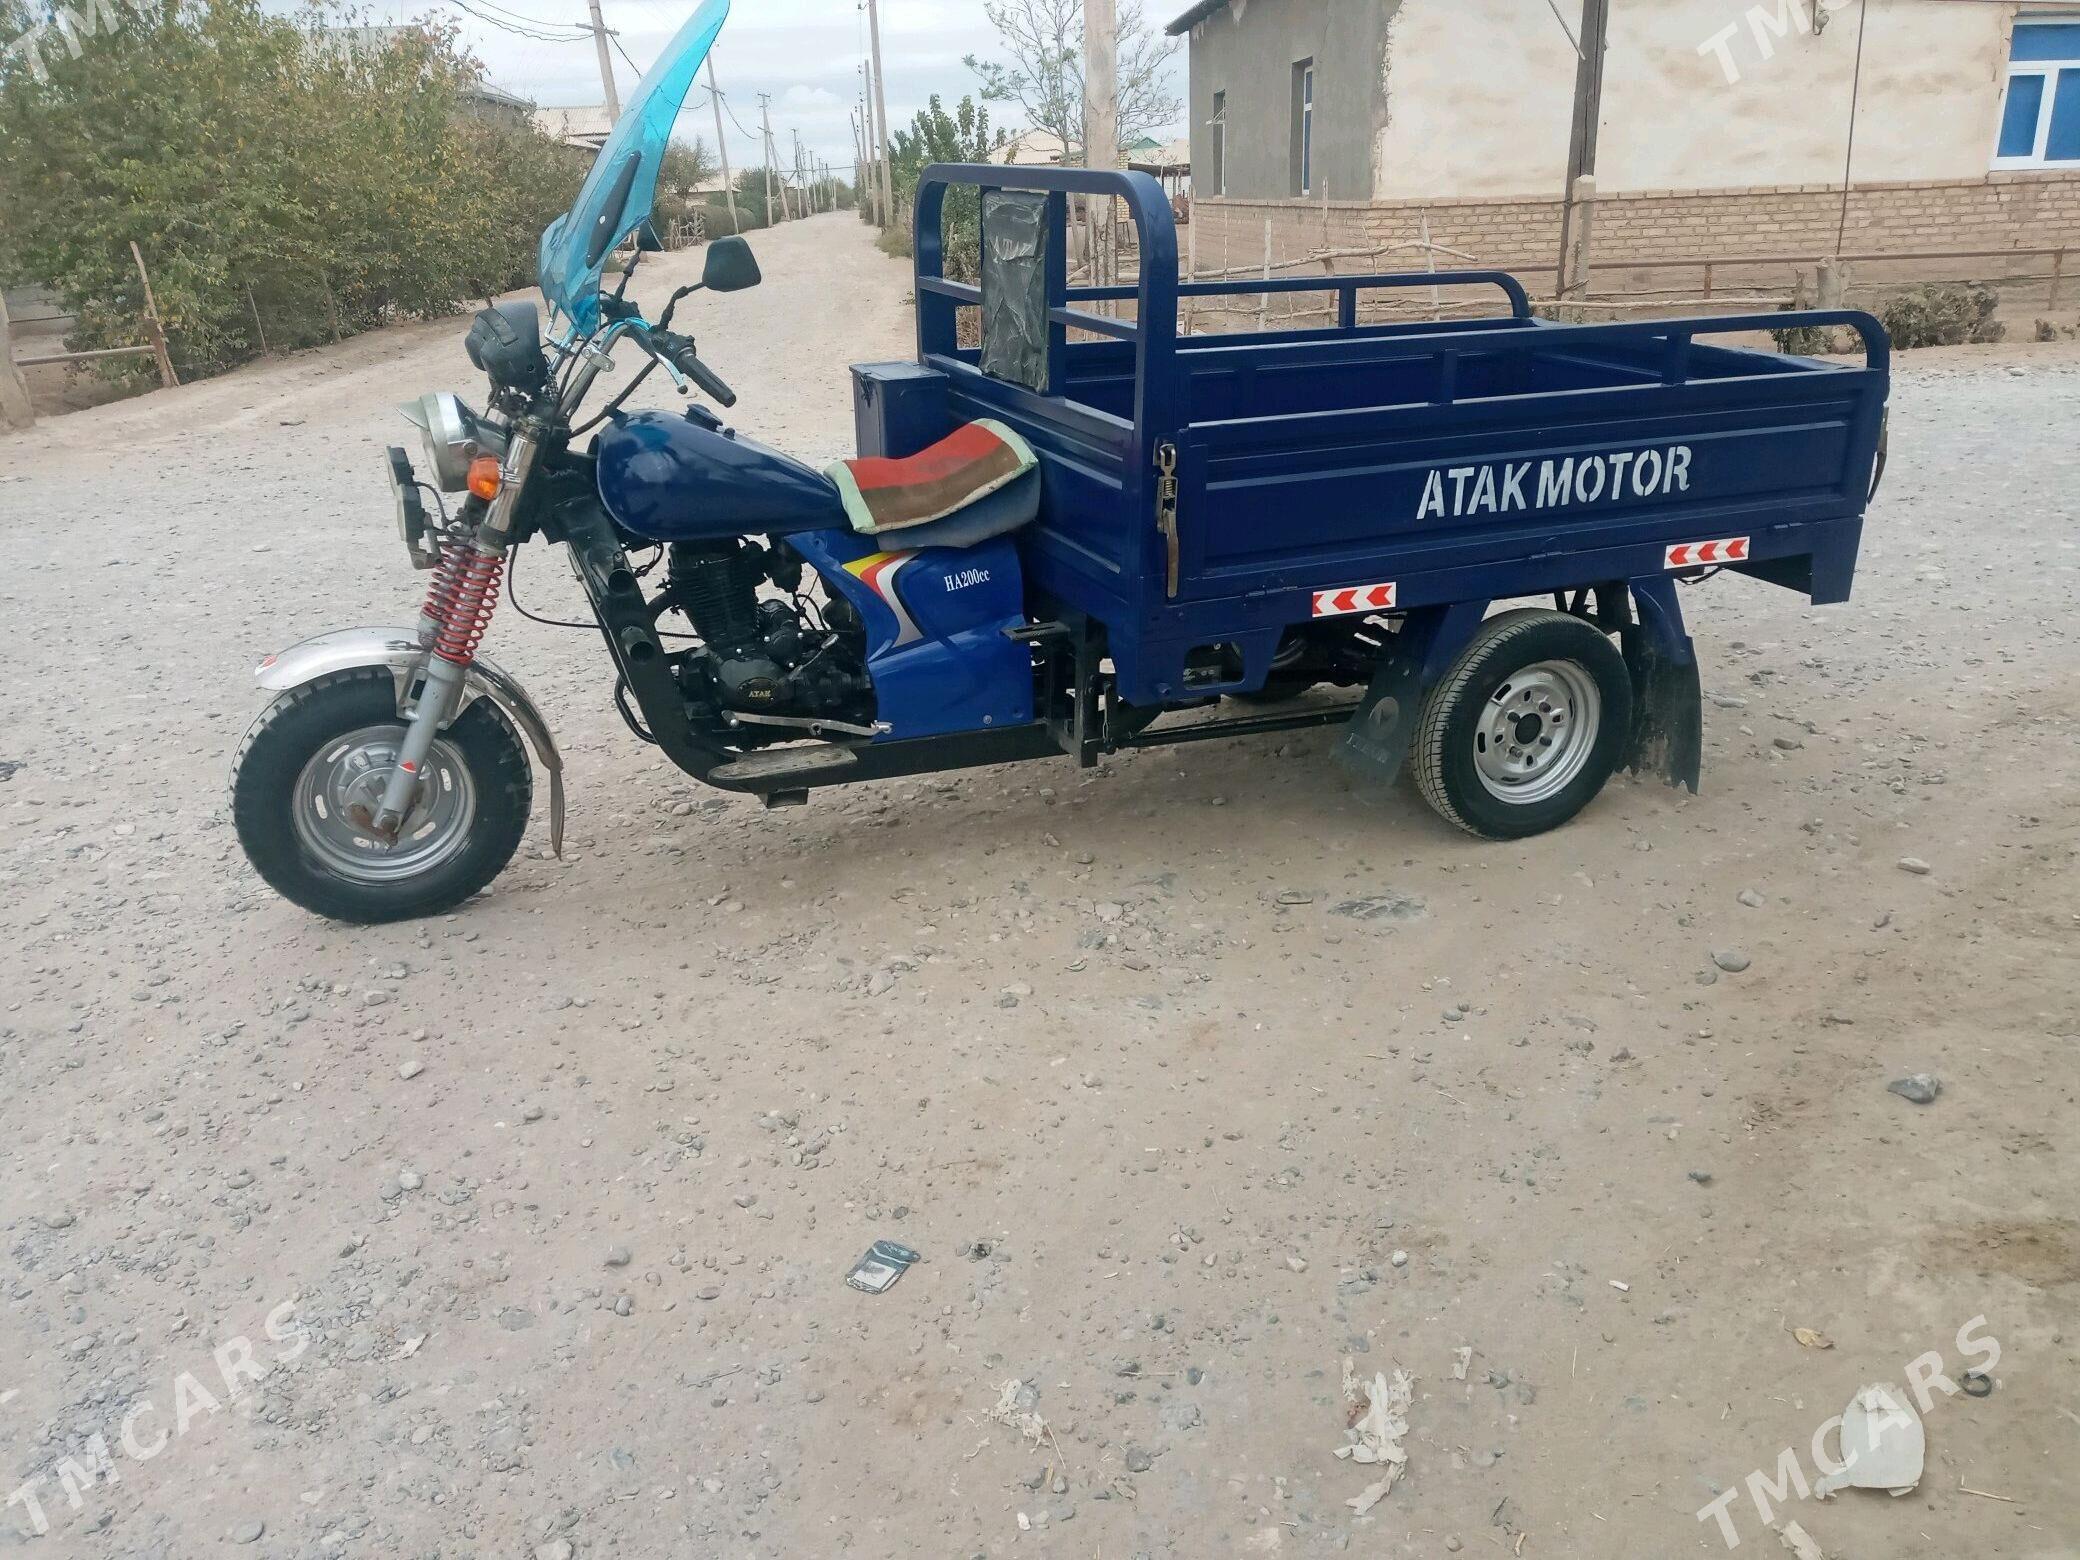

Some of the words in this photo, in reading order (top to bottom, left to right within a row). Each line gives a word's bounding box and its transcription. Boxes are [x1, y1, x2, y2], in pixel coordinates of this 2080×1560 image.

[1416, 462, 1532, 520] ATAK
[1536, 446, 1692, 508] MOTOR
[944, 568, 990, 592] HA200cc
